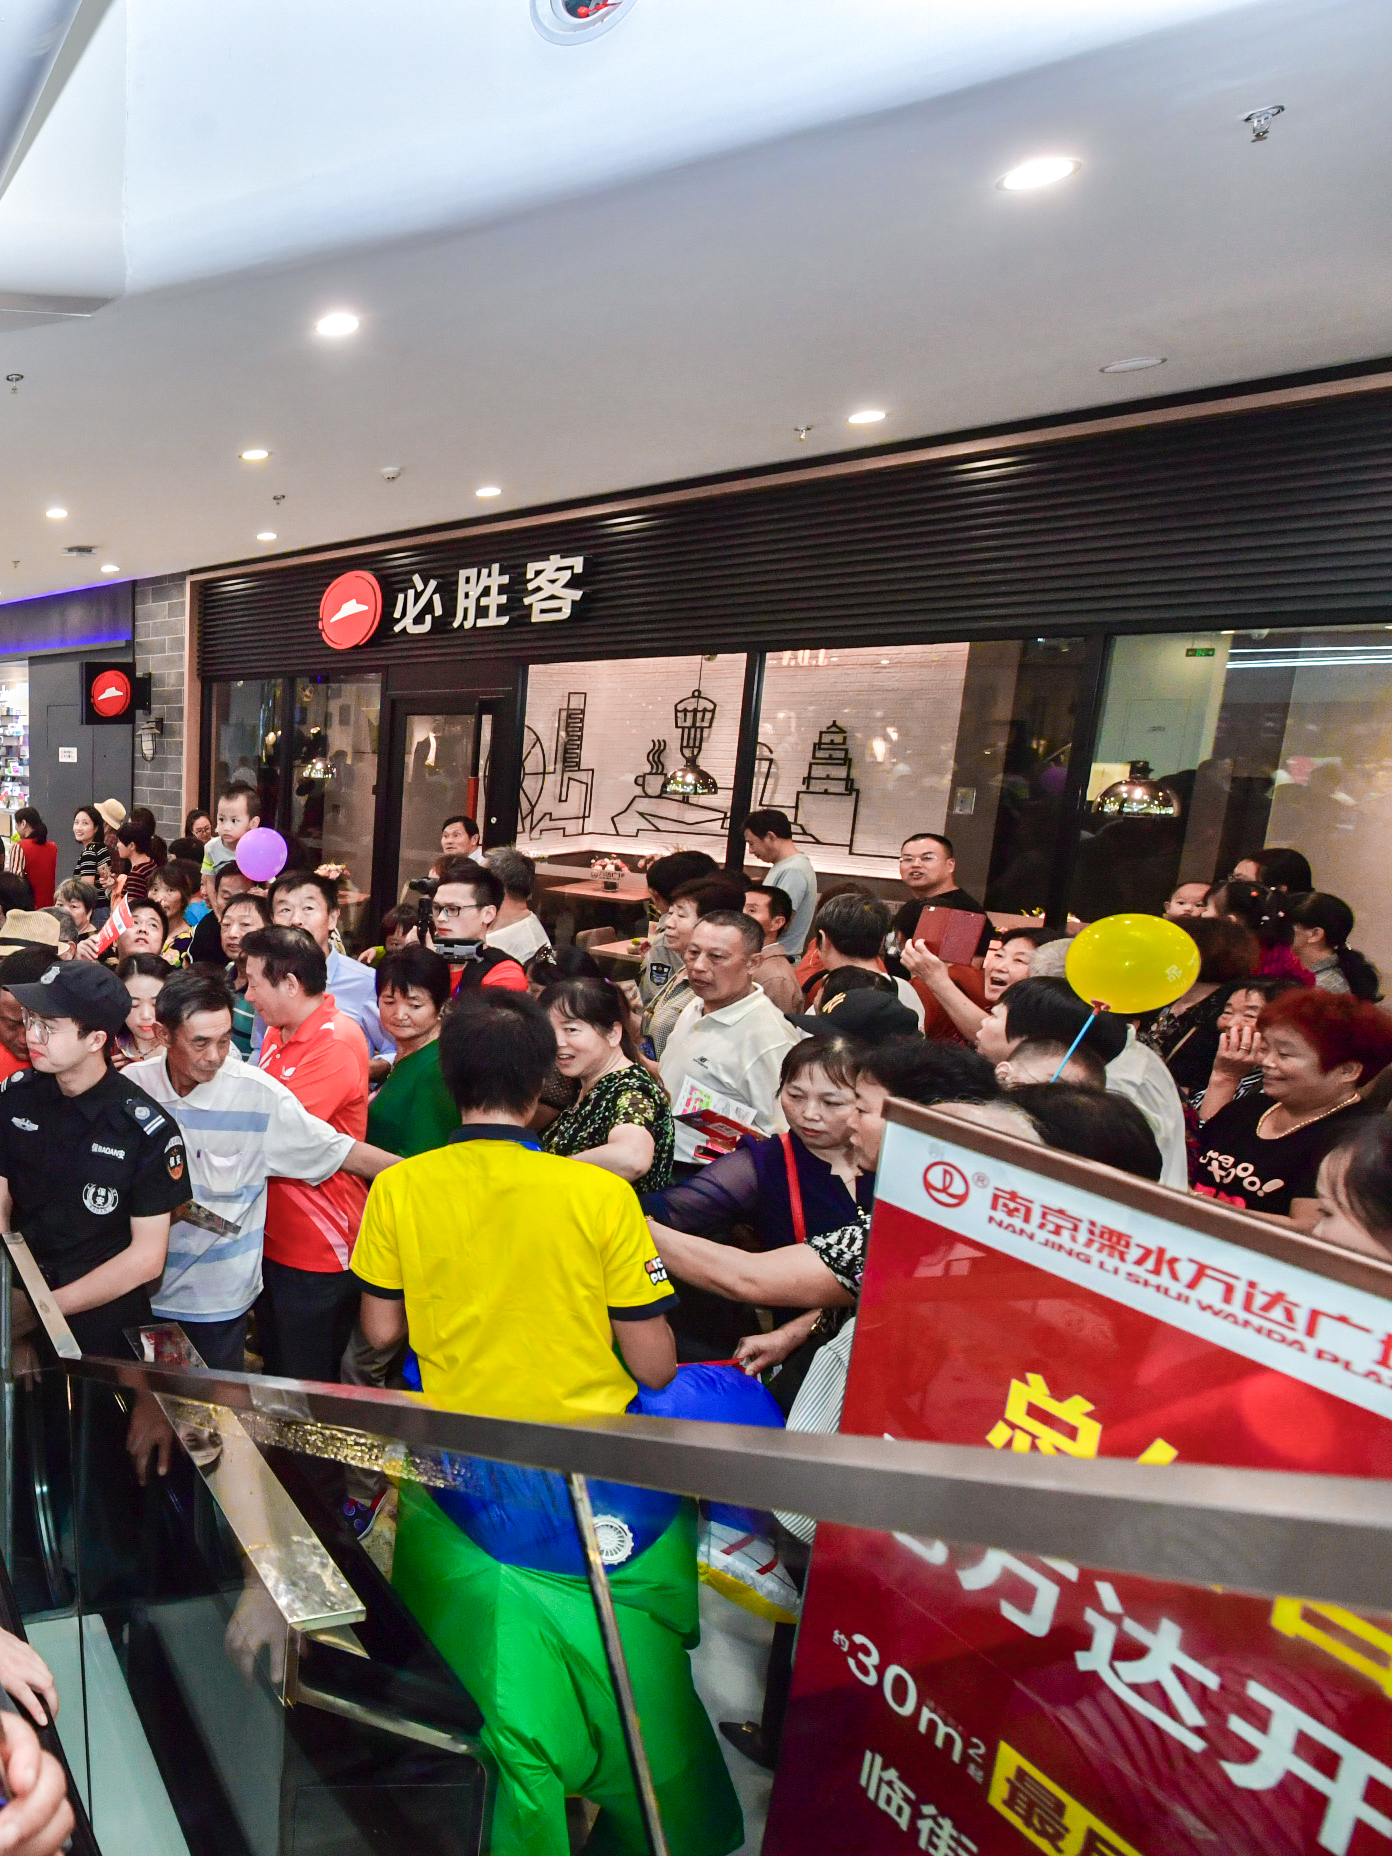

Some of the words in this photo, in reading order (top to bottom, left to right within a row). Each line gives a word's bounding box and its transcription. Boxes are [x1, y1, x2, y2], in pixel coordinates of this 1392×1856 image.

[393, 553, 586, 635] 必胜客
[1098, 1260, 1121, 1277] LI
[1124, 1271, 1191, 1304] SHUI
[1194, 1298, 1308, 1353] WANDA
[1314, 1347, 1392, 1391] PLA
